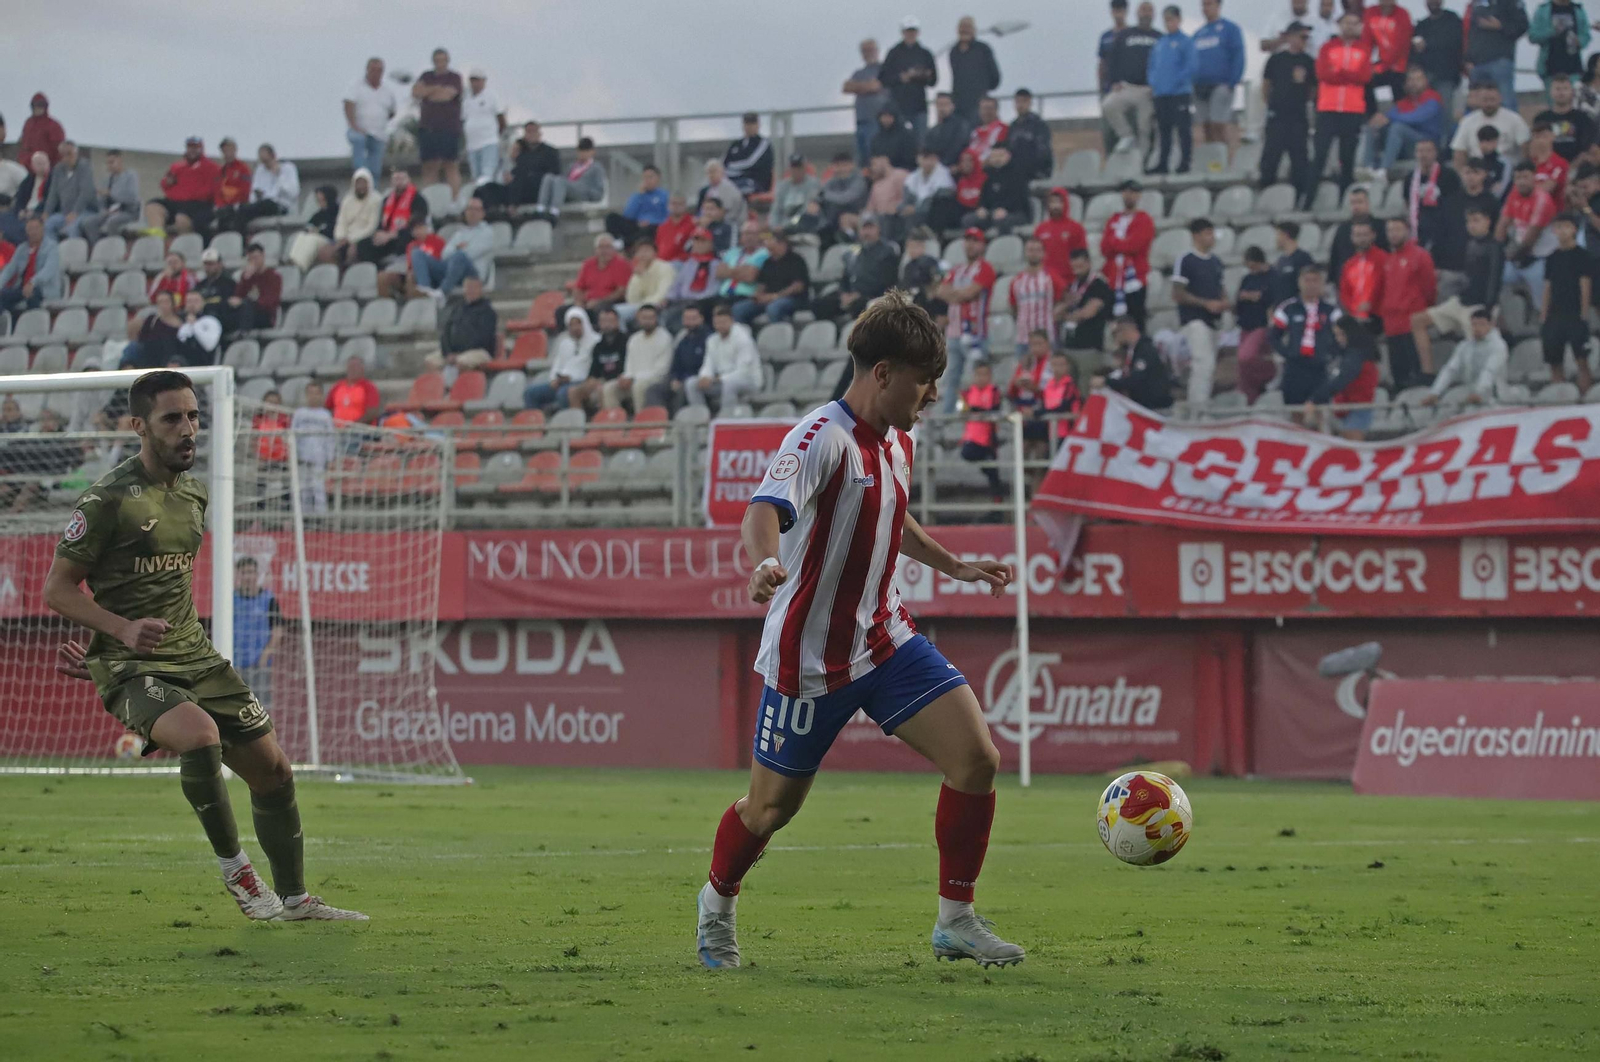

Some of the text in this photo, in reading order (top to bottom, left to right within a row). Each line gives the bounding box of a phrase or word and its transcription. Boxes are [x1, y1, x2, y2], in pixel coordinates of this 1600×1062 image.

[1052, 411, 1592, 513] ALGECIRAS
[282, 561, 370, 592] HTECSE
[467, 539, 604, 581] MOLINO
[606, 539, 655, 578] DE
[1230, 549, 1427, 594] BESOCCER
[356, 699, 624, 743] Grazalema Motor
[777, 692, 815, 735] 10
